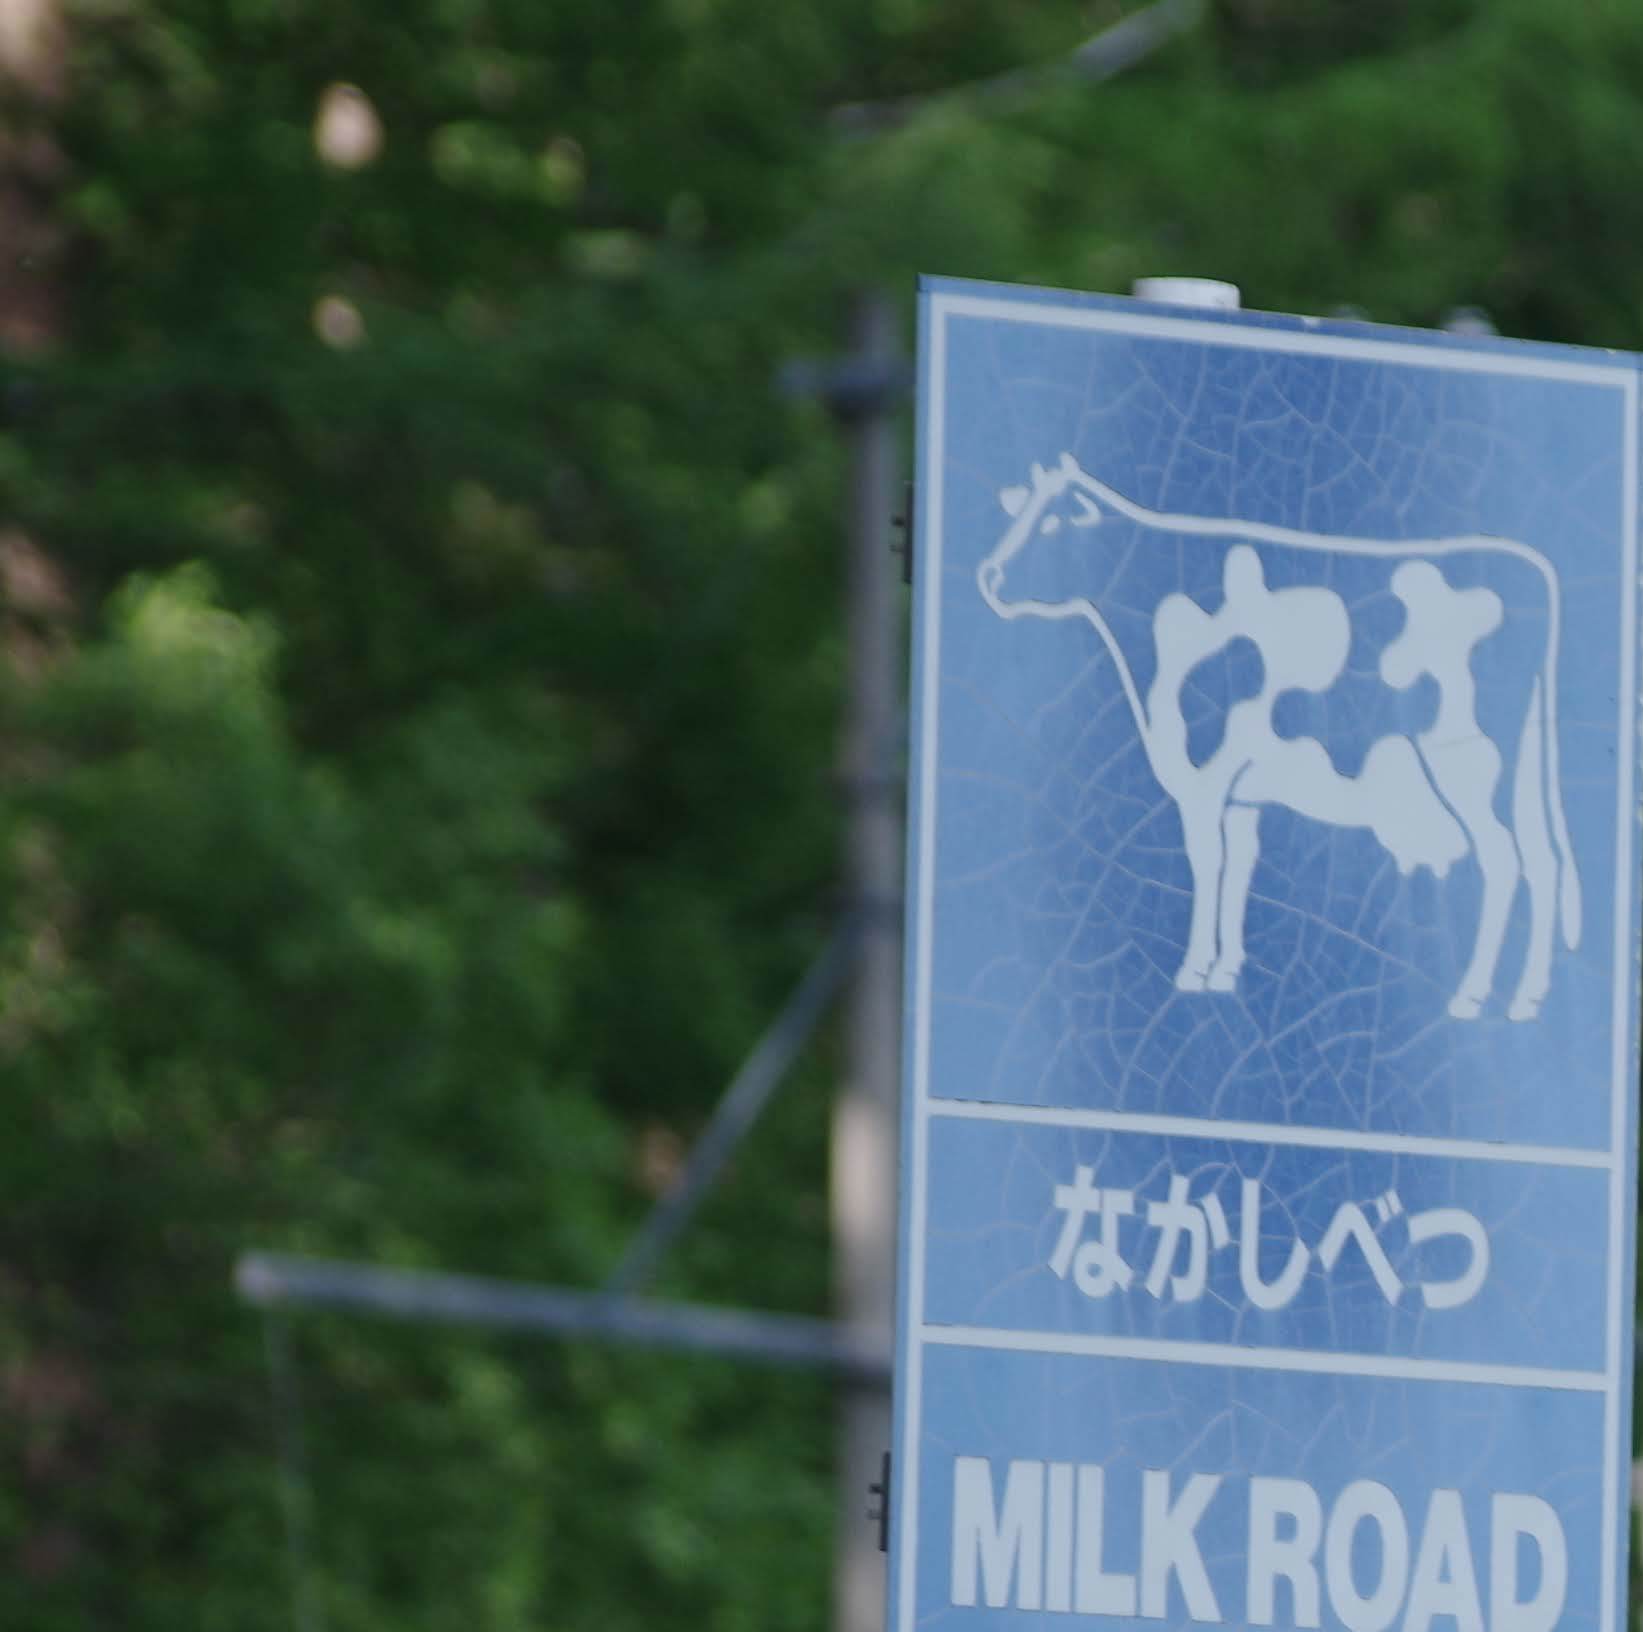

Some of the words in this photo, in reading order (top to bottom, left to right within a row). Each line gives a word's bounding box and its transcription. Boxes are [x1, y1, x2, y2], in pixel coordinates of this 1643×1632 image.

[1048, 1164, 1491, 1311] なかしべつ
[950, 1454, 1224, 1624] MILK
